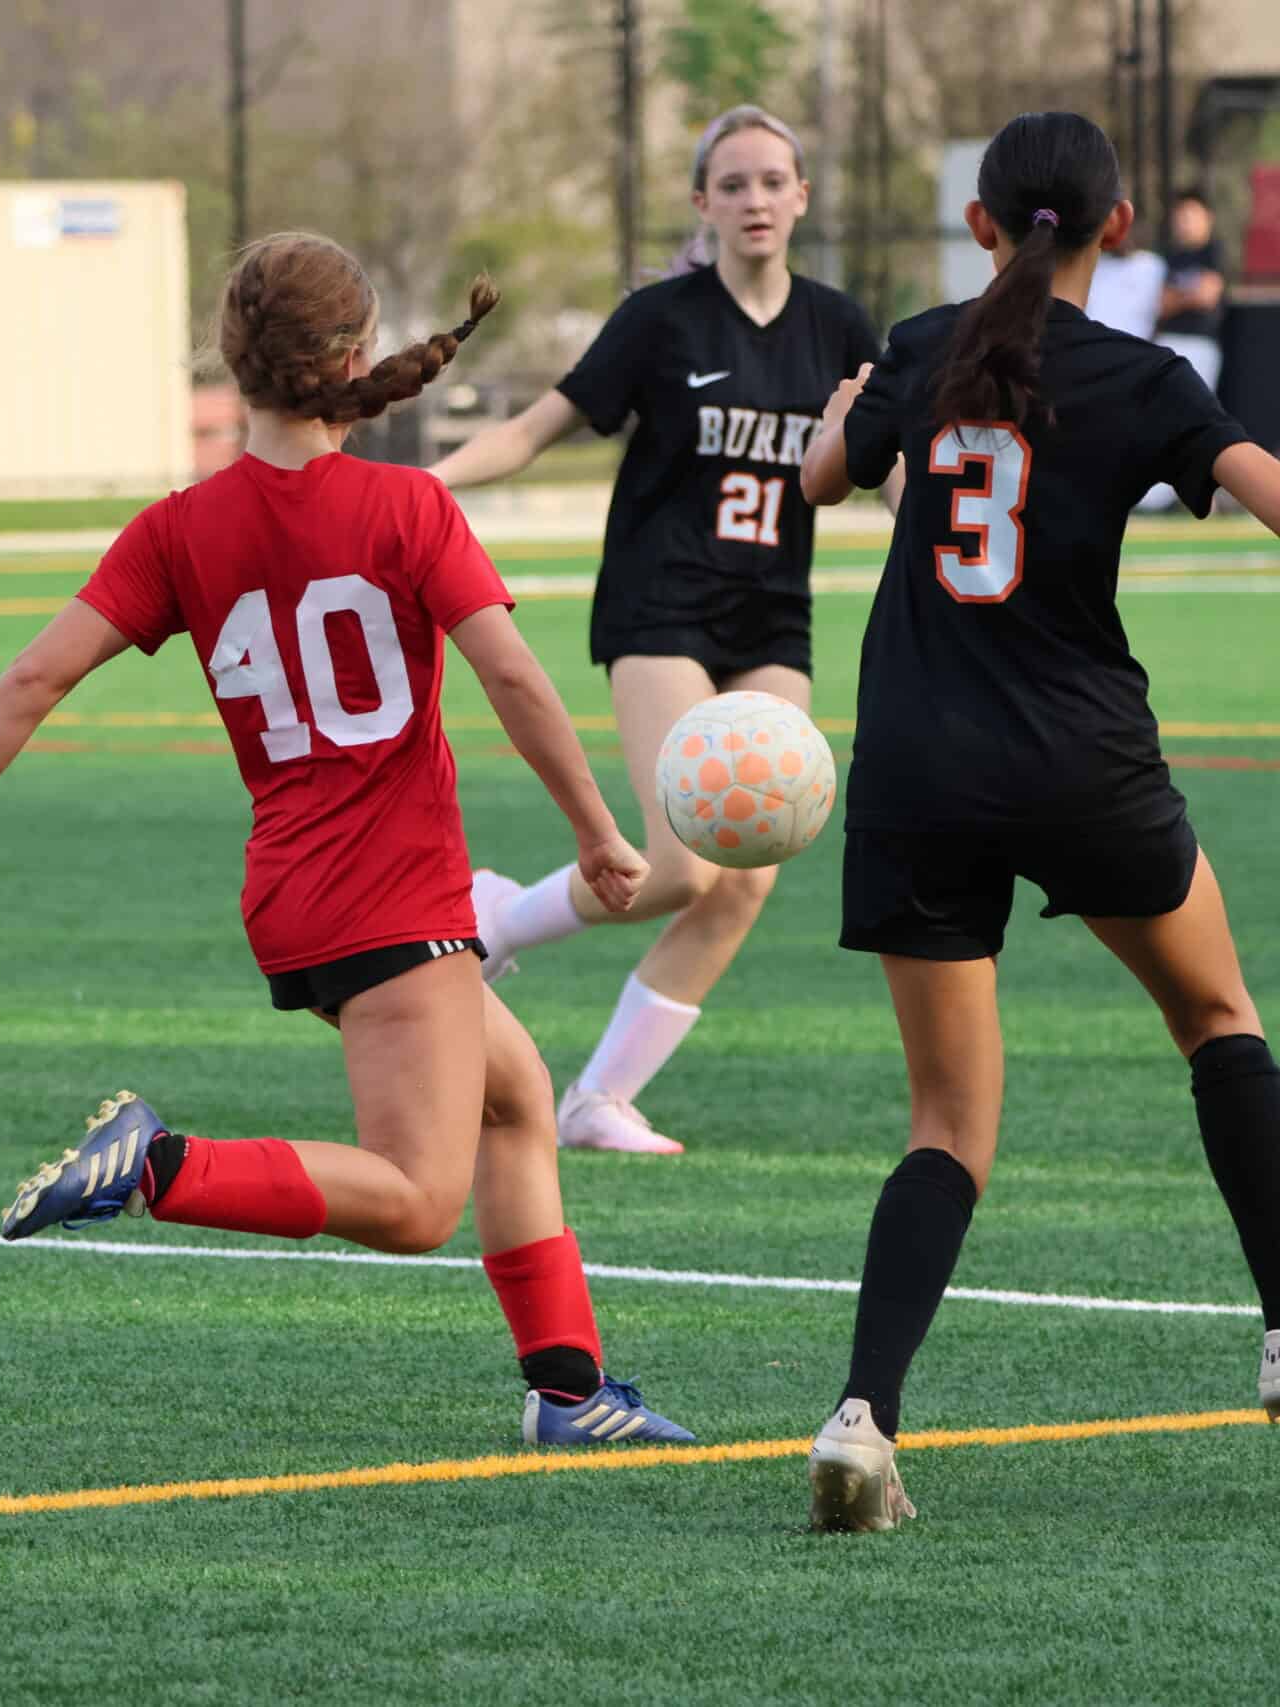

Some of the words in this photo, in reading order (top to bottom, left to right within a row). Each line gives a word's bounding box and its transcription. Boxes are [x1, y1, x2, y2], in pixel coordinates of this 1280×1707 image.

[716, 471, 784, 548] 21
[928, 420, 1033, 604] 3
[207, 573, 415, 763] 40
